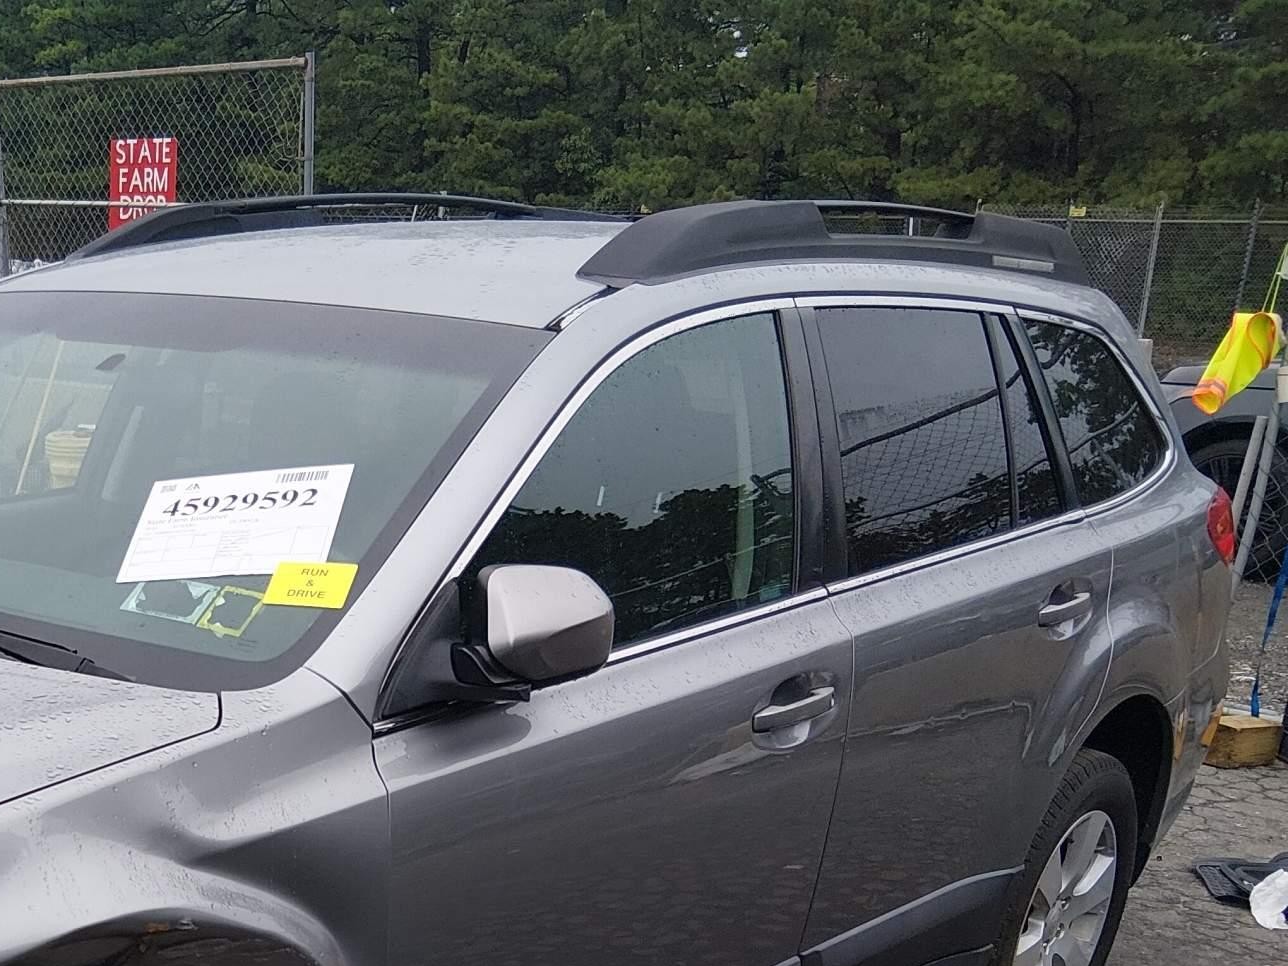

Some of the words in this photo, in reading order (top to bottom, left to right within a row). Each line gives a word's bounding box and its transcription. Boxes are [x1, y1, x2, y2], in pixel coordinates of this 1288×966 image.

[115, 137, 172, 164] STATE
[118, 166, 169, 193] FARM
[162, 488, 318, 516] 45929592
[300, 567, 329, 577] RUN
[305, 579, 314, 587] &
[287, 589, 326, 599] DRIVE
